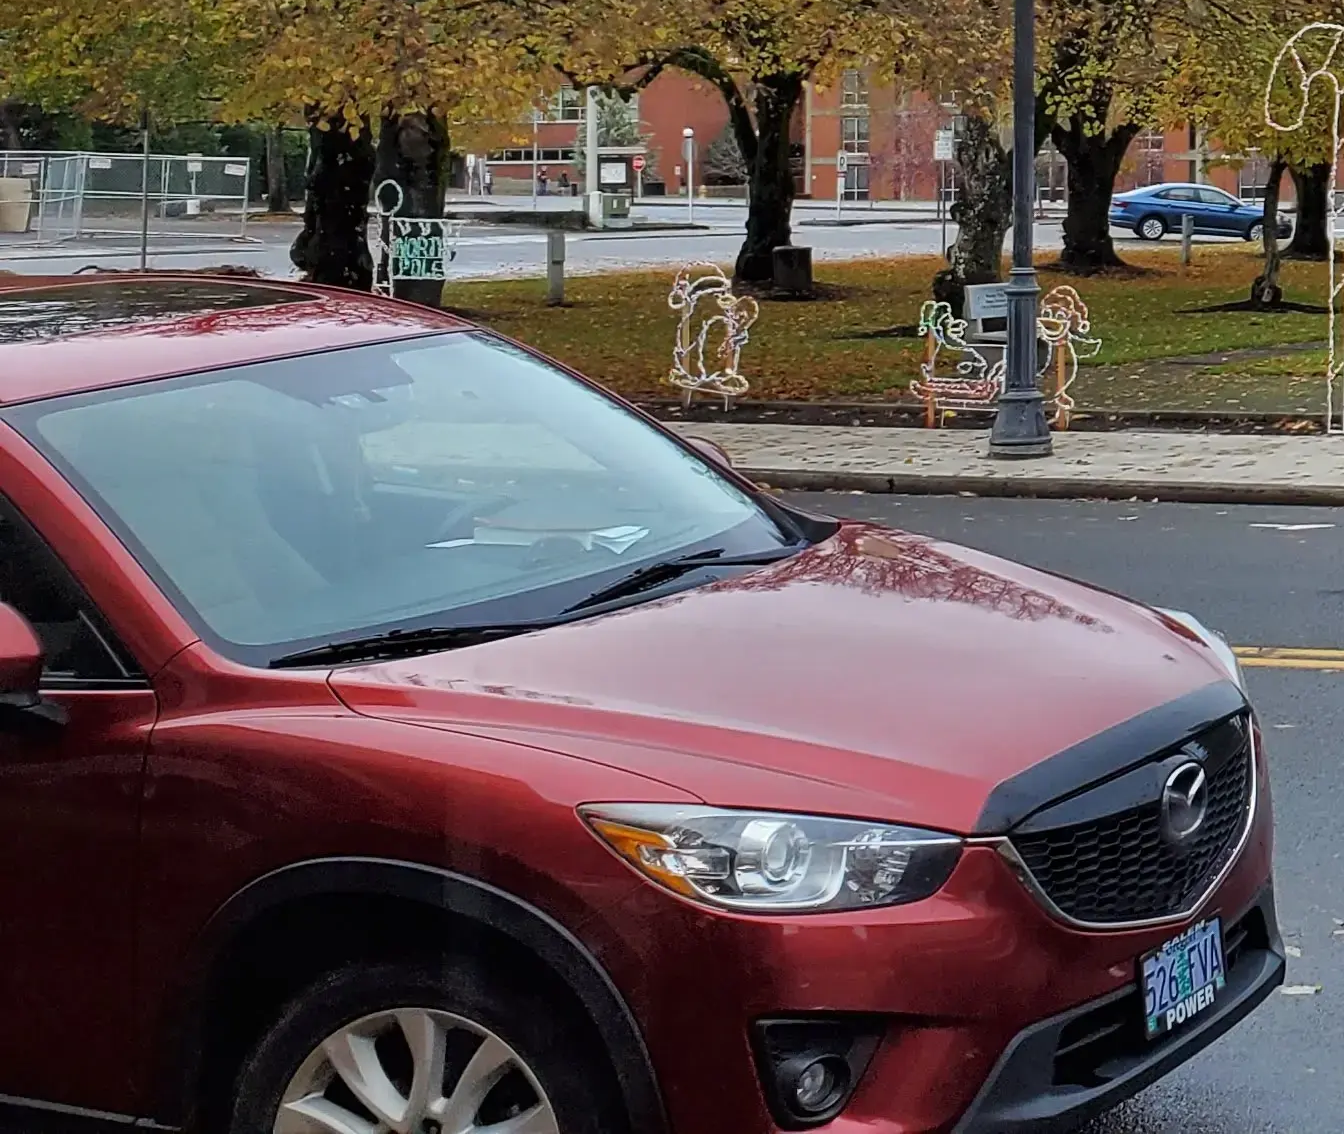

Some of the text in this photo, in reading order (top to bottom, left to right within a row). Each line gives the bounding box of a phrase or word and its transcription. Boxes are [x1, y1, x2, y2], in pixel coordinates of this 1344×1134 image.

[392, 236, 446, 257] NORTH
[399, 258, 444, 276] POLE
[1145, 933, 1222, 1016] 526 FVA
[1166, 983, 1215, 1030] POWER
